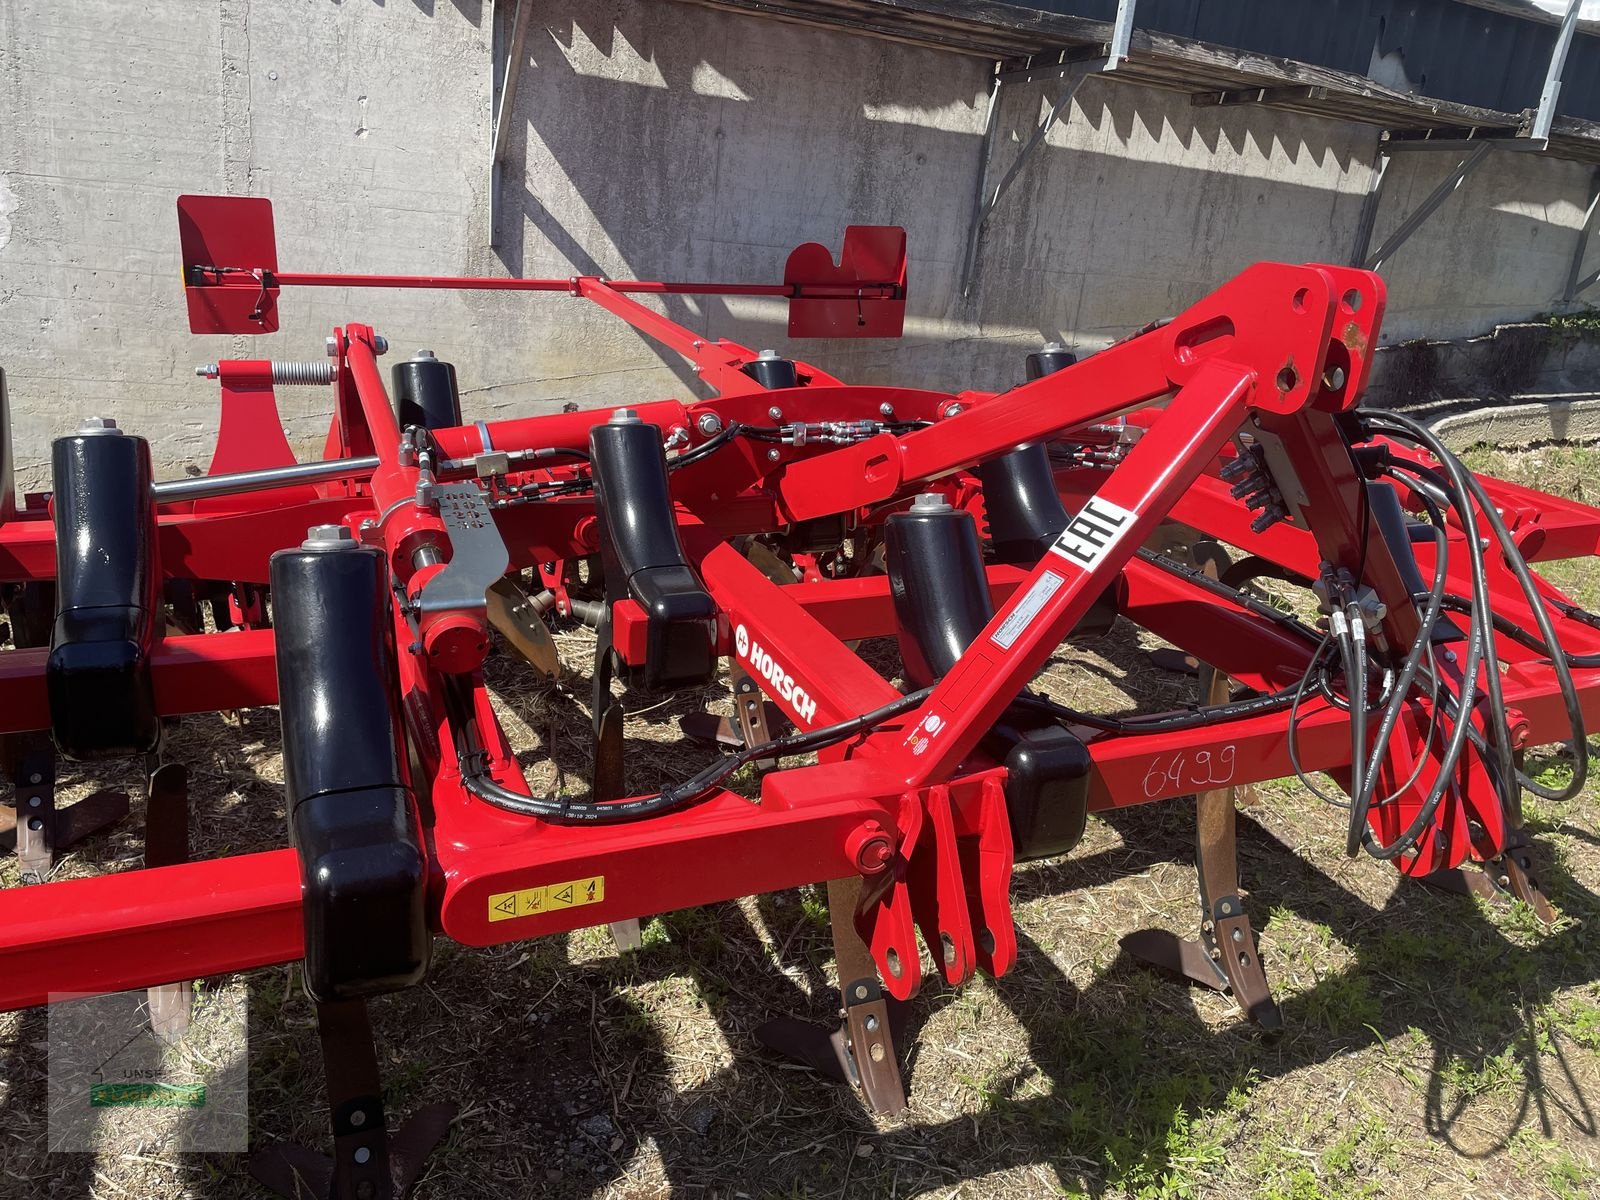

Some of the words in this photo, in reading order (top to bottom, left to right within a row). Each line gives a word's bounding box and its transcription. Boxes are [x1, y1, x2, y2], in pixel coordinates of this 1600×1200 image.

[1054, 501, 1128, 565] EAC
[750, 641, 817, 725] HORSCH
[1142, 745, 1236, 797] 6499
